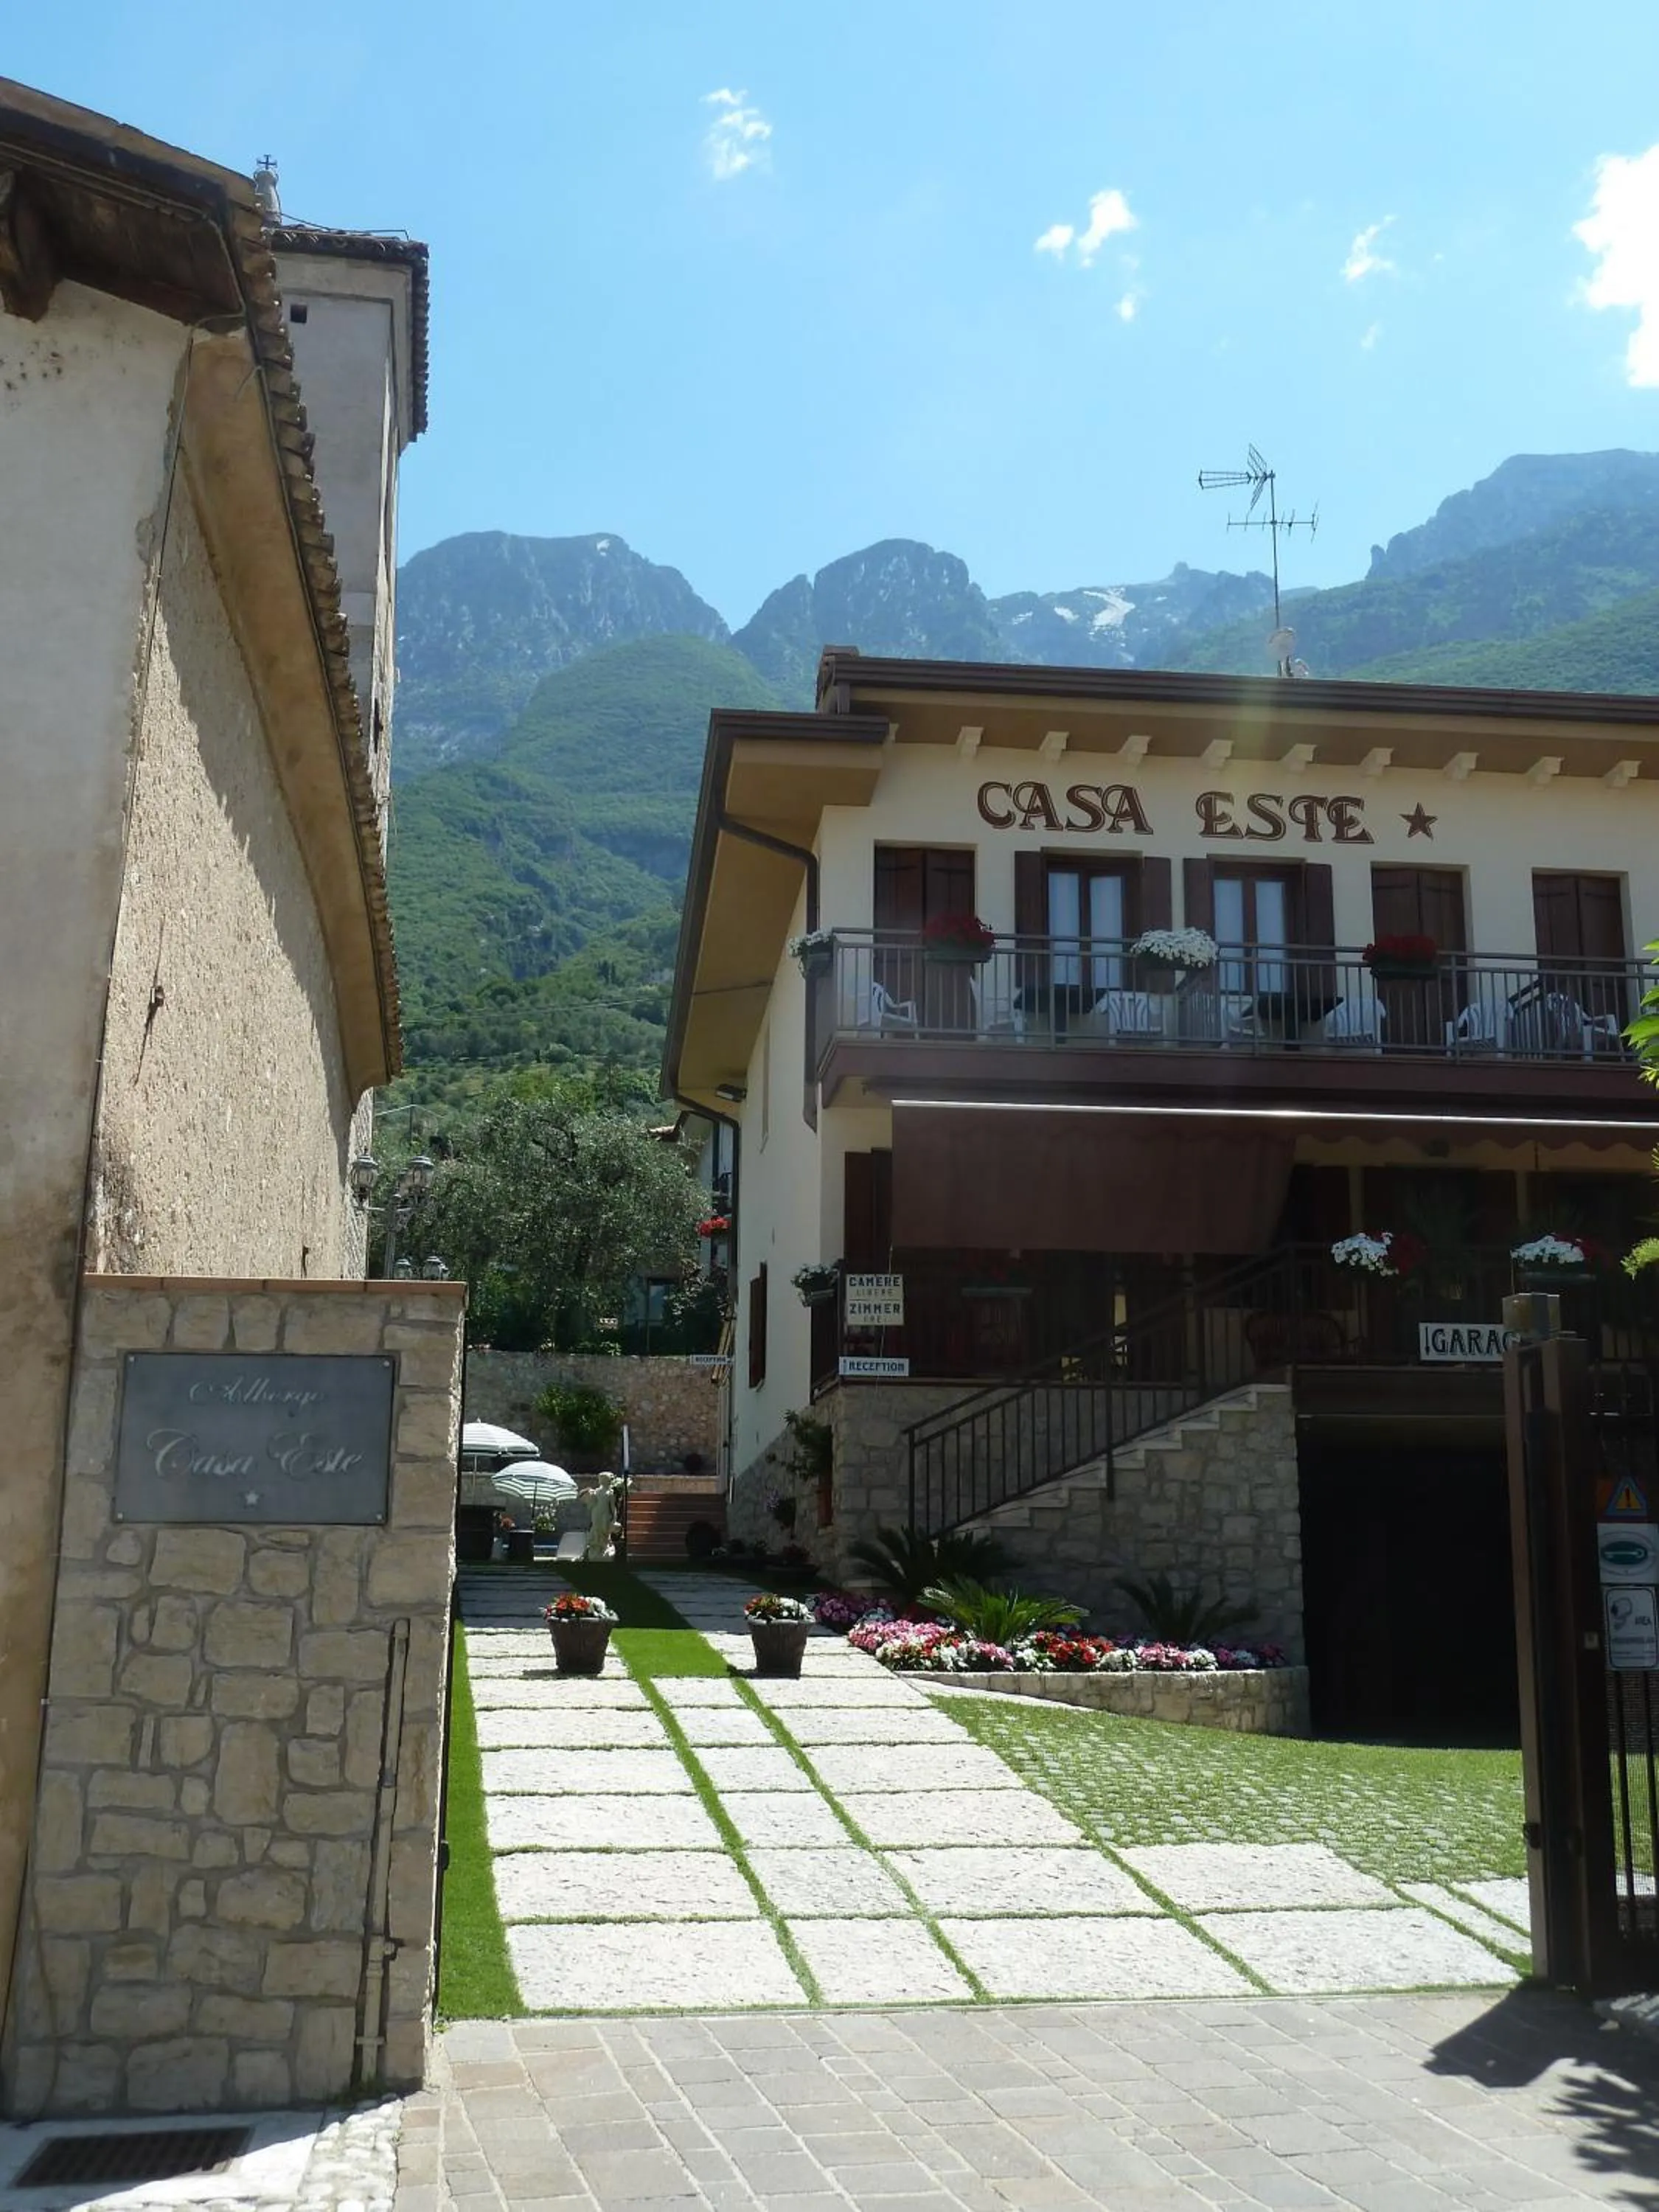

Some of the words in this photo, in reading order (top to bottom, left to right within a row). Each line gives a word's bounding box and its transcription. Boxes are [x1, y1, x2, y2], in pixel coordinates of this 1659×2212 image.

[977, 781, 1153, 835] CASA
[1194, 790, 1374, 844] ESTE
[849, 1276, 900, 1287] CAMERE
[849, 1303, 900, 1314] ZIMMER
[849, 1360, 905, 1372] RECEPTION
[146, 1428, 257, 1478] Casa
[268, 1430, 366, 1481] Este
